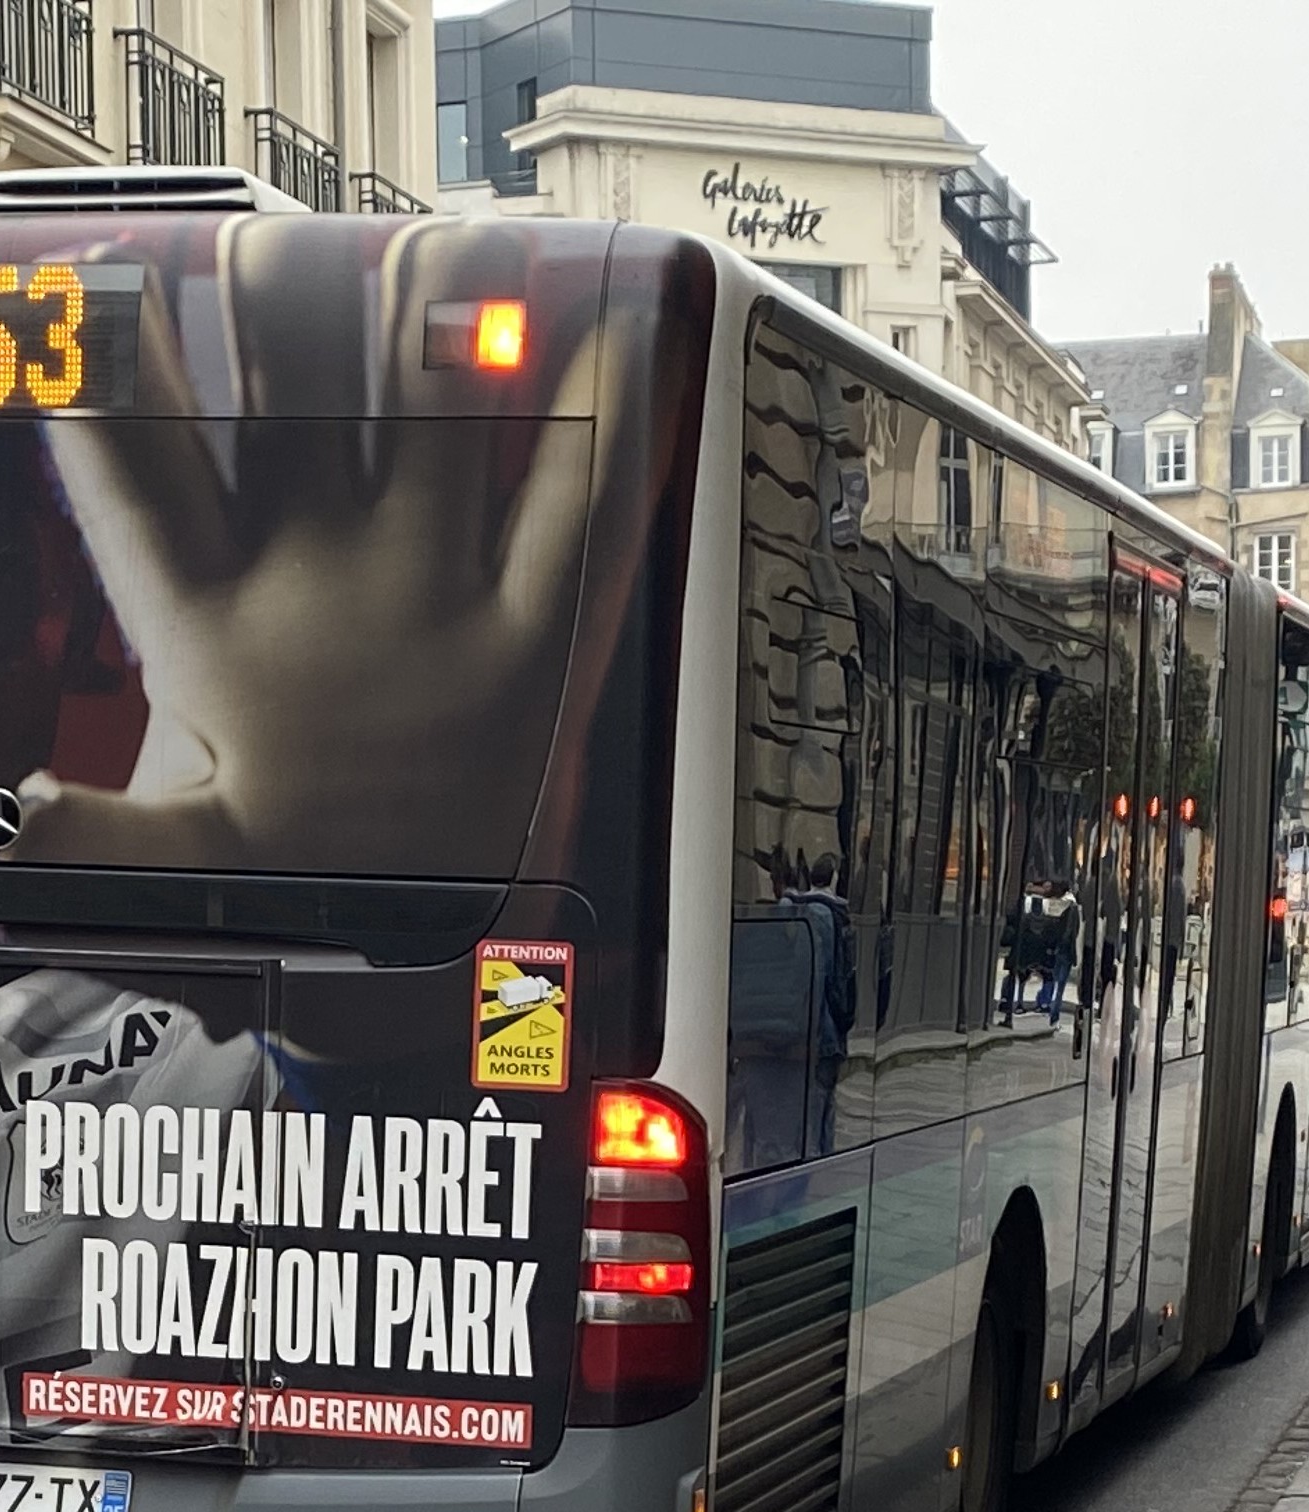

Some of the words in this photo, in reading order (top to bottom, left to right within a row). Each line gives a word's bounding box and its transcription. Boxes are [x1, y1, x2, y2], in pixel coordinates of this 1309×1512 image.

[482, 944, 568, 961] ATTENTION
[487, 1044, 555, 1060] ANGLES
[489, 1062, 551, 1078] MORTS
[24, 1099, 326, 1229] PROCHAIN
[339, 1096, 542, 1240] ARRÊT
[80, 1237, 360, 1366] ROAZHON
[373, 1253, 539, 1378] PARK
[28, 1370, 168, 1419] RÉSERVEZ
[176, 1388, 227, 1422] SUR
[229, 1389, 525, 1444] STADERENNAIS.COM
